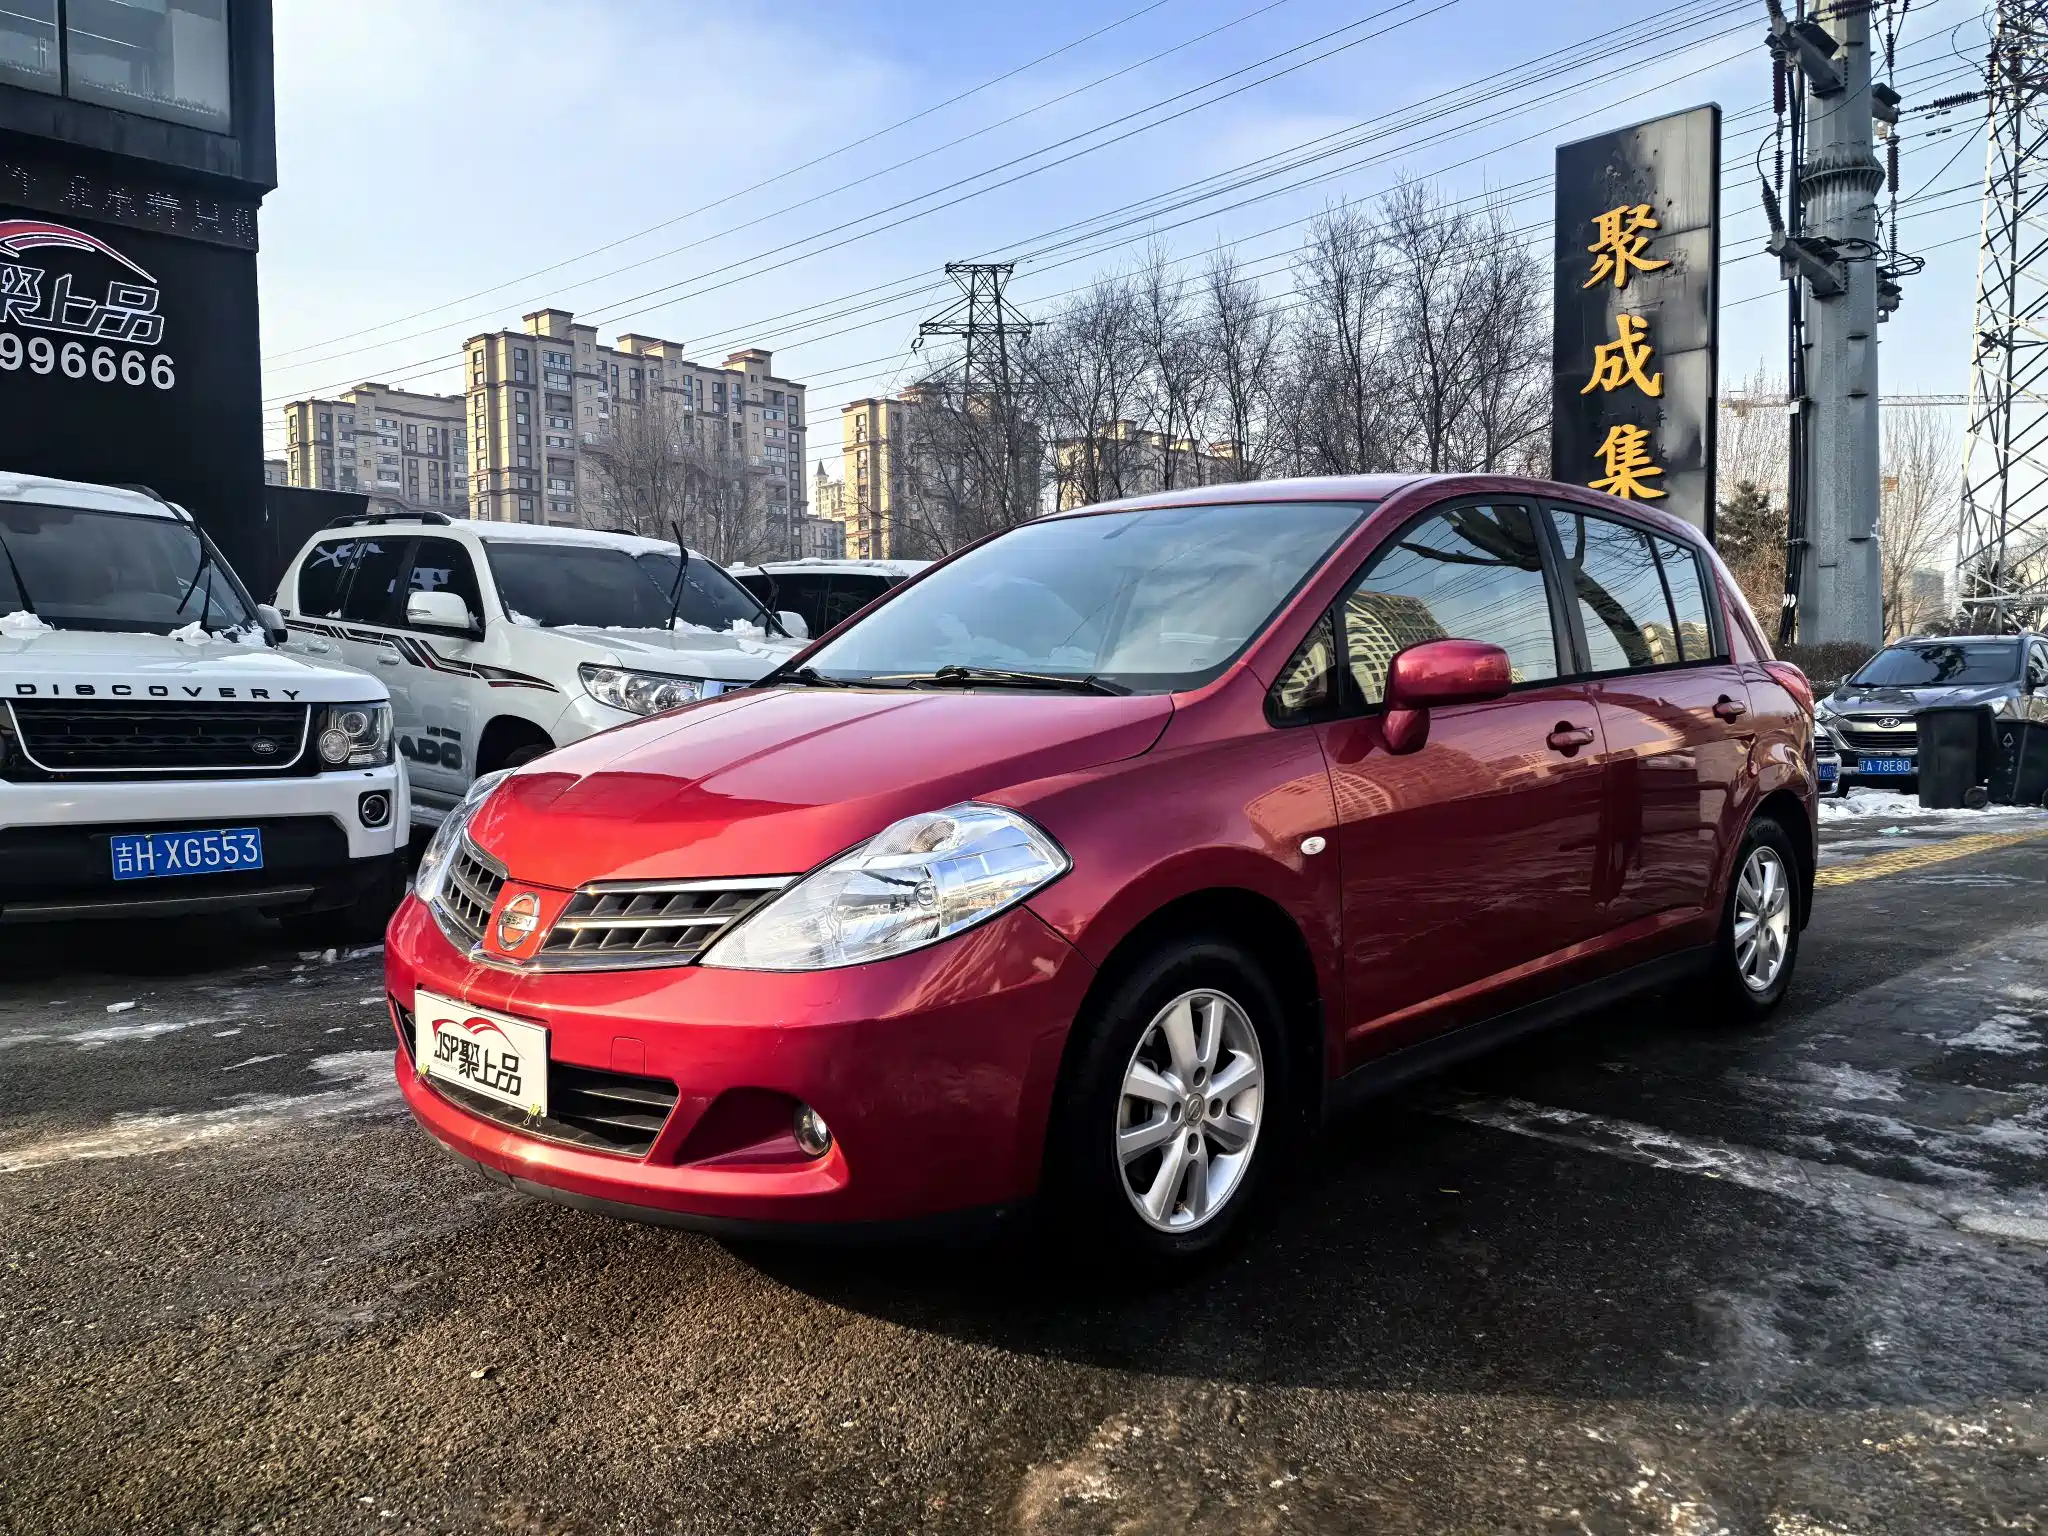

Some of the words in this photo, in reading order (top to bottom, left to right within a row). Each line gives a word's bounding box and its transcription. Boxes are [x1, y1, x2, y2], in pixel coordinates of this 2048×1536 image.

[1581, 203, 1670, 499] 聚成集
[15, 683, 301, 700] DISCOVERY
